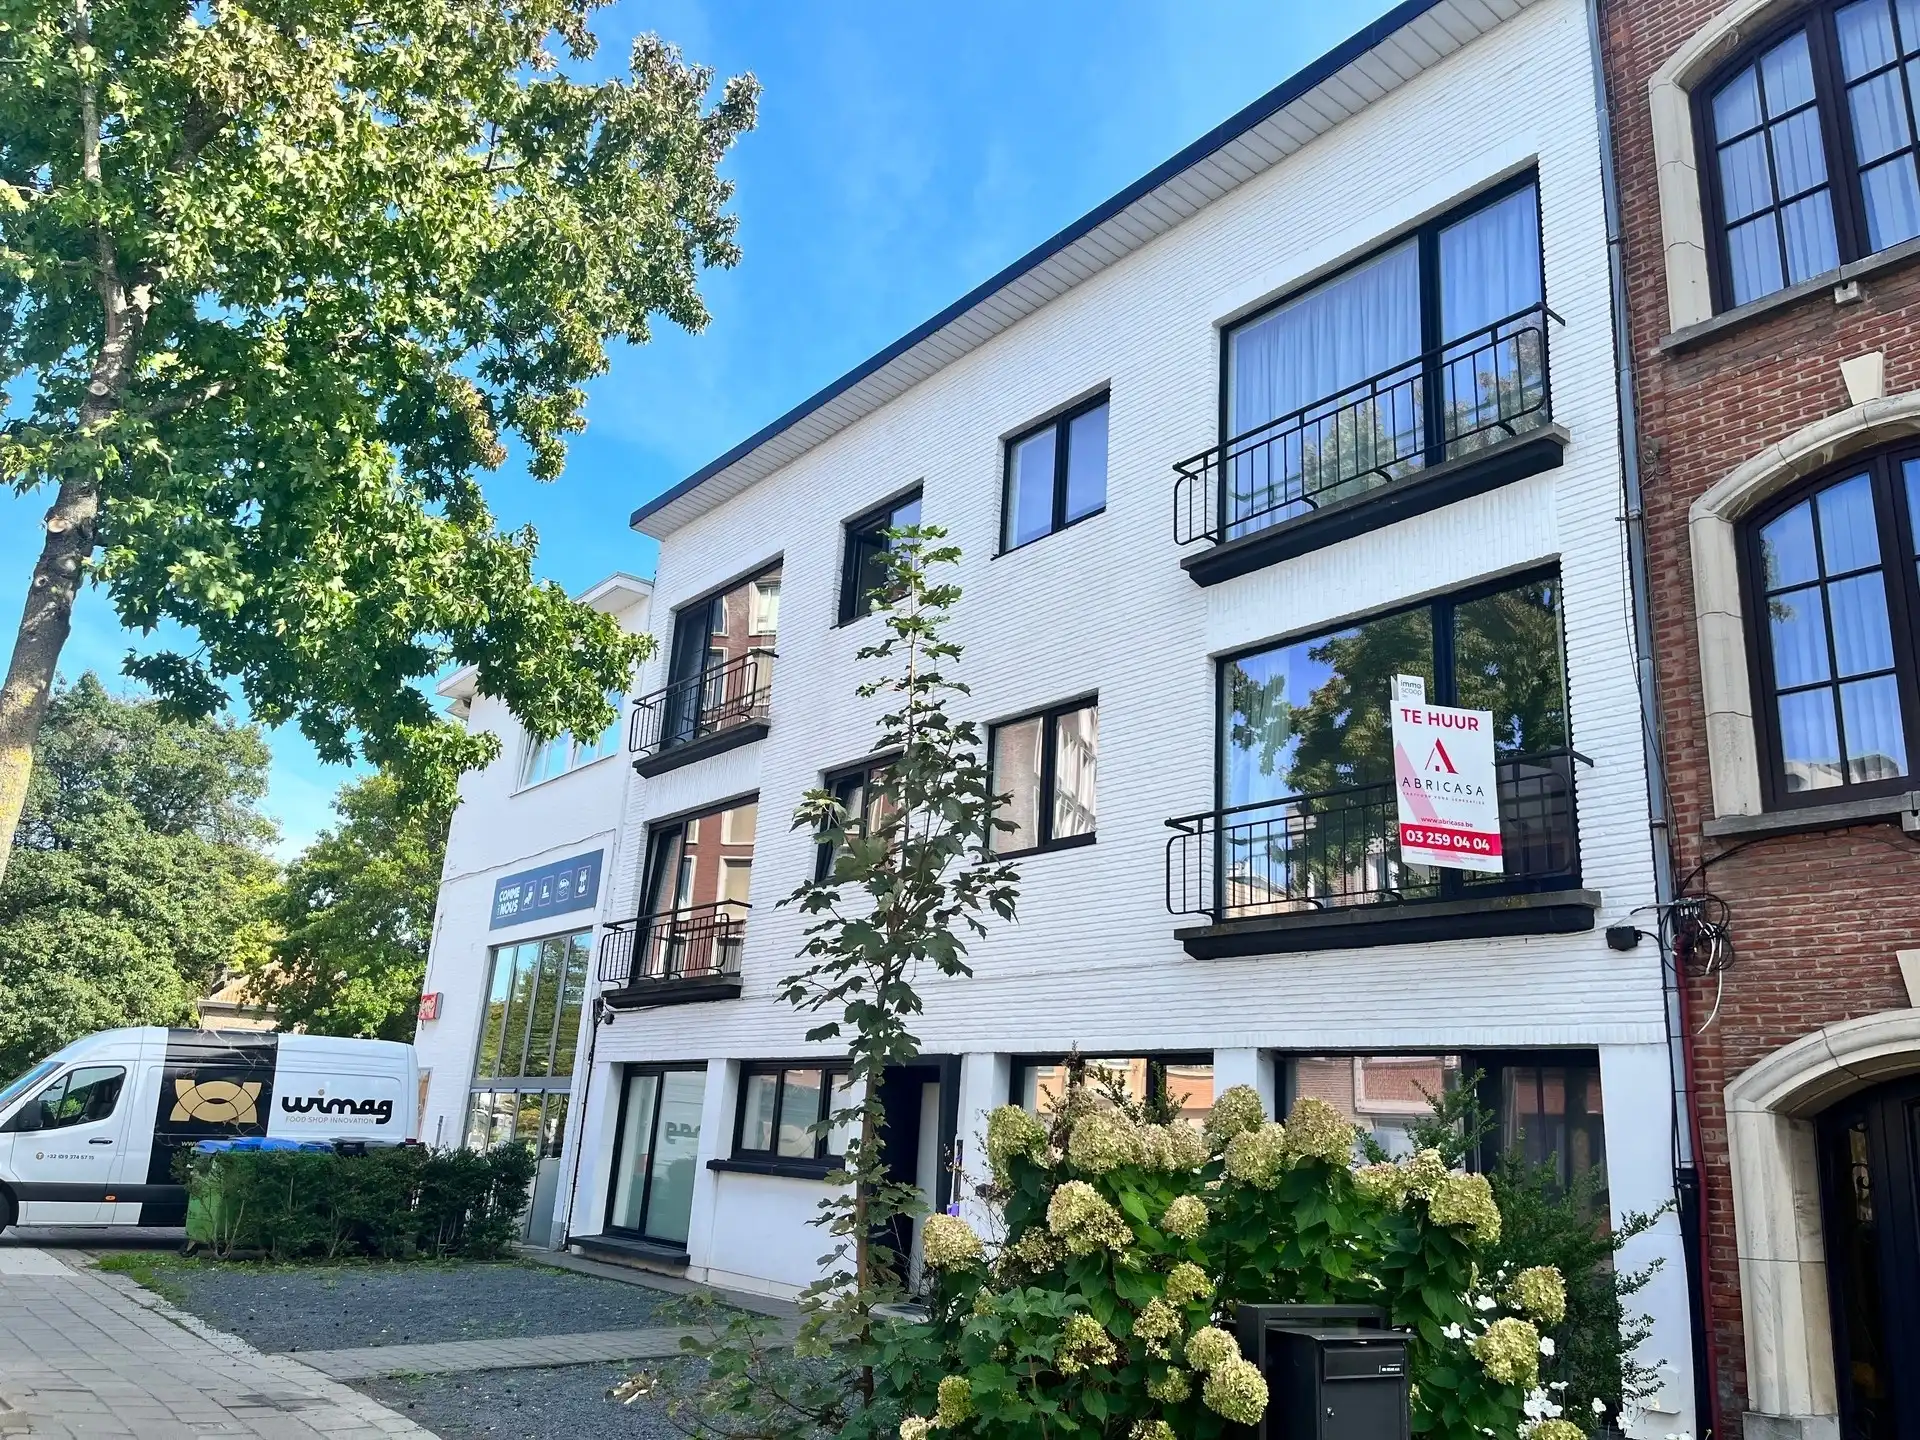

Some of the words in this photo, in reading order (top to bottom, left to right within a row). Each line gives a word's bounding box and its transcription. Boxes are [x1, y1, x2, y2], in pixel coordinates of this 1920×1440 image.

[1400, 680, 1422, 689] immo
[1401, 687, 1423, 696] scoop
[1400, 708, 1422, 724] TE
[1428, 712, 1479, 731] HUUR
[1402, 776, 1485, 797] ABRICASA
[1420, 816, 1474, 828] www.abricasa.be
[1405, 829, 1424, 843] 03
[1426, 832, 1450, 846] 259
[1453, 835, 1471, 849] 04
[1473, 837, 1490, 851] 04
[281, 1088, 394, 1125] wimag
[285, 1115, 306, 1123] FOOD
